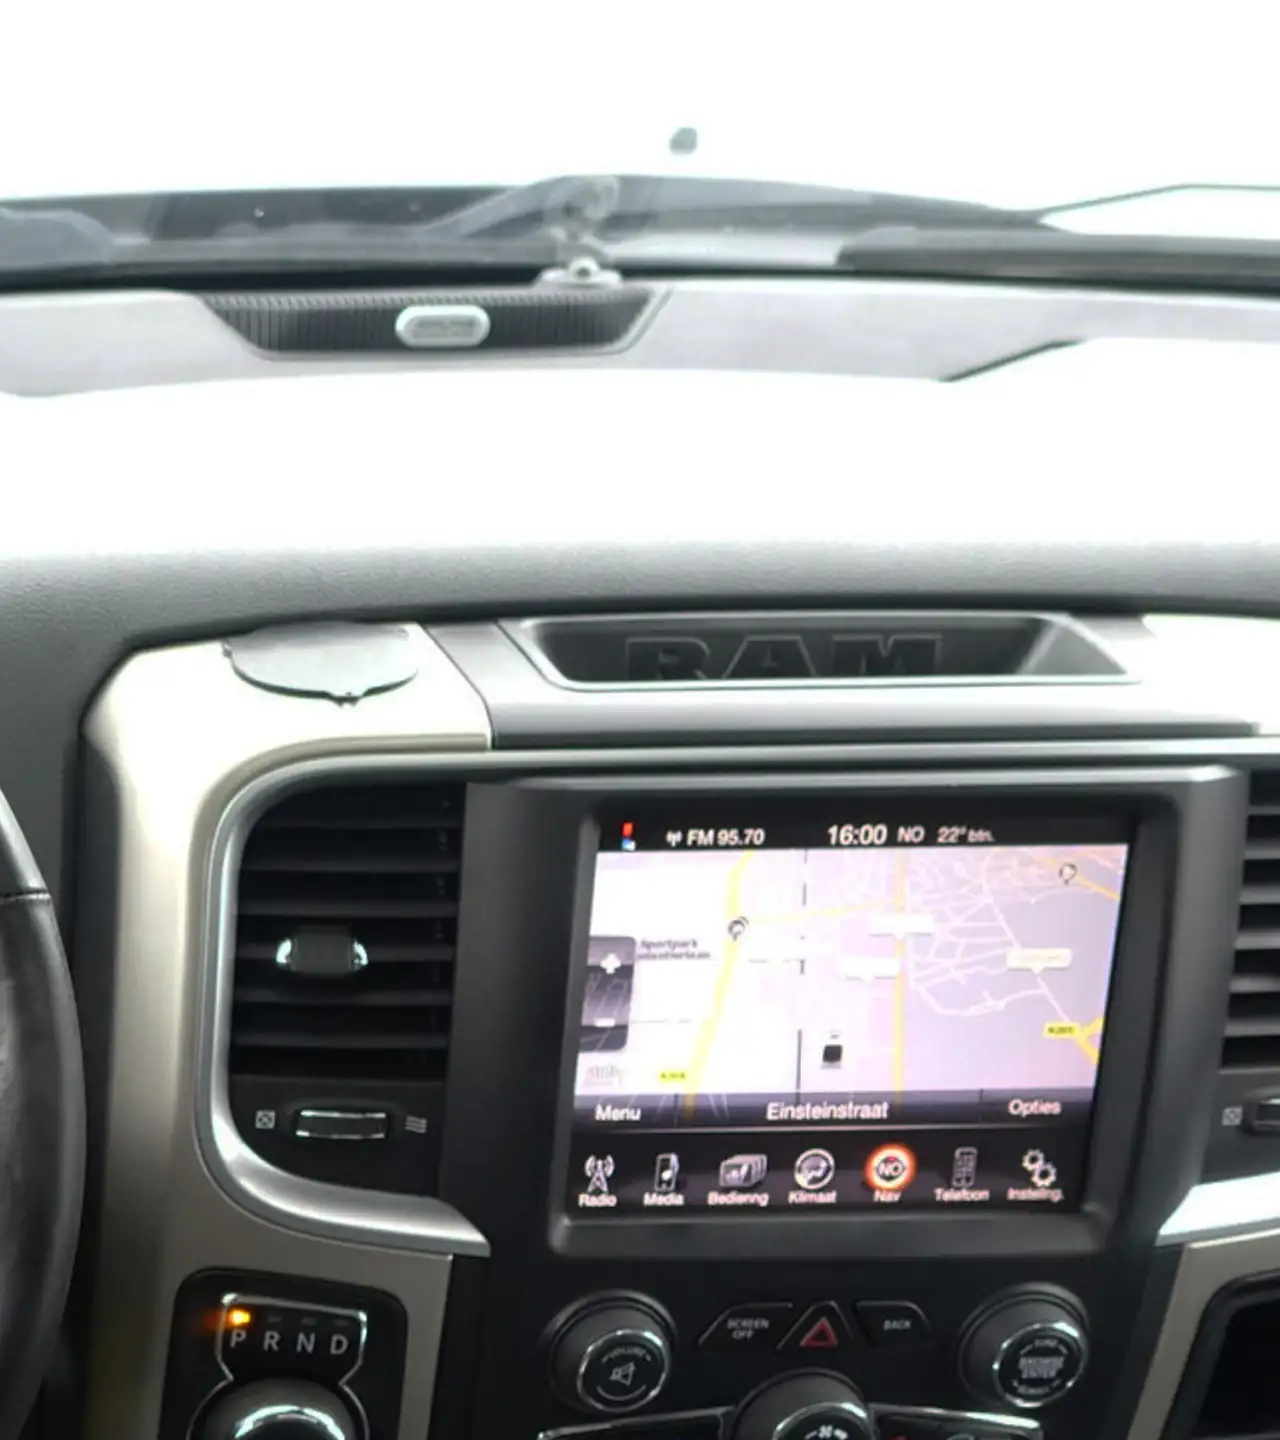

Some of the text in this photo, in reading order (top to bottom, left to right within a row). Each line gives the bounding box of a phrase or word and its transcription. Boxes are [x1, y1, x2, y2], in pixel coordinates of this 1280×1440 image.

[625, 634, 941, 679] RAM
[687, 829, 715, 846] FM
[718, 828, 766, 846] 95.70
[827, 824, 888, 846] 16:00
[897, 826, 925, 843] NO
[595, 1098, 1062, 1121] Menu Einsteinstraat Opties
[578, 1192, 618, 1207] Radio
[643, 1191, 685, 1207] Media
[788, 1189, 837, 1205] Klimaat
[874, 1189, 902, 1203] Nav
[934, 1187, 990, 1202] Telefoon
[726, 1318, 770, 1329] SCREEN
[883, 1319, 912, 1331] BACK
[230, 1328, 349, 1355] P R N D
[732, 1329, 754, 1340] OFF
